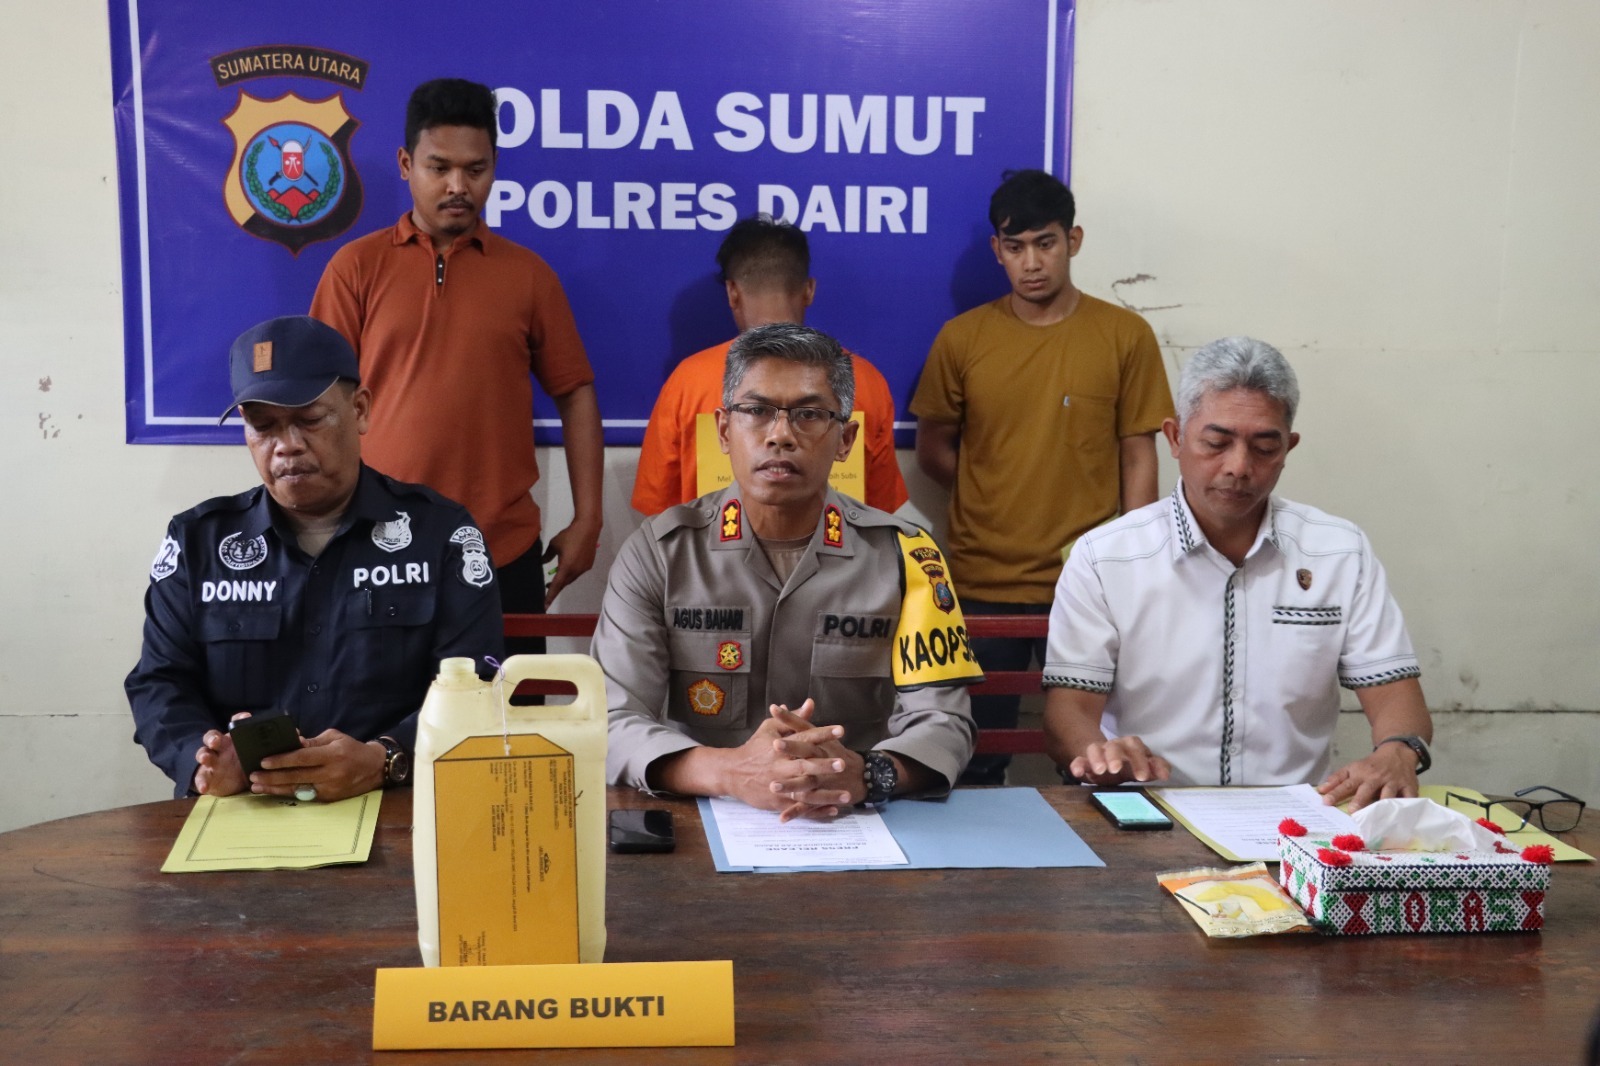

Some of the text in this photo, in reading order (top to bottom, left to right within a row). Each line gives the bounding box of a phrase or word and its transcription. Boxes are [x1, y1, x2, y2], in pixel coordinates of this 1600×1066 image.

[217, 53, 361, 84] SUMATERA UTARA
[492, 86, 986, 156] OLDA SUMUT
[485, 180, 928, 234] POLRES DAIRI
[354, 561, 430, 588] POLRI
[202, 580, 278, 602] DONNY
[673, 607, 702, 629] AGUS
[823, 614, 892, 638] POLRI
[899, 625, 975, 675] KAOPS
[1373, 889, 1518, 933] HORAS
[428, 996, 665, 1022] BARANG BUKTI
